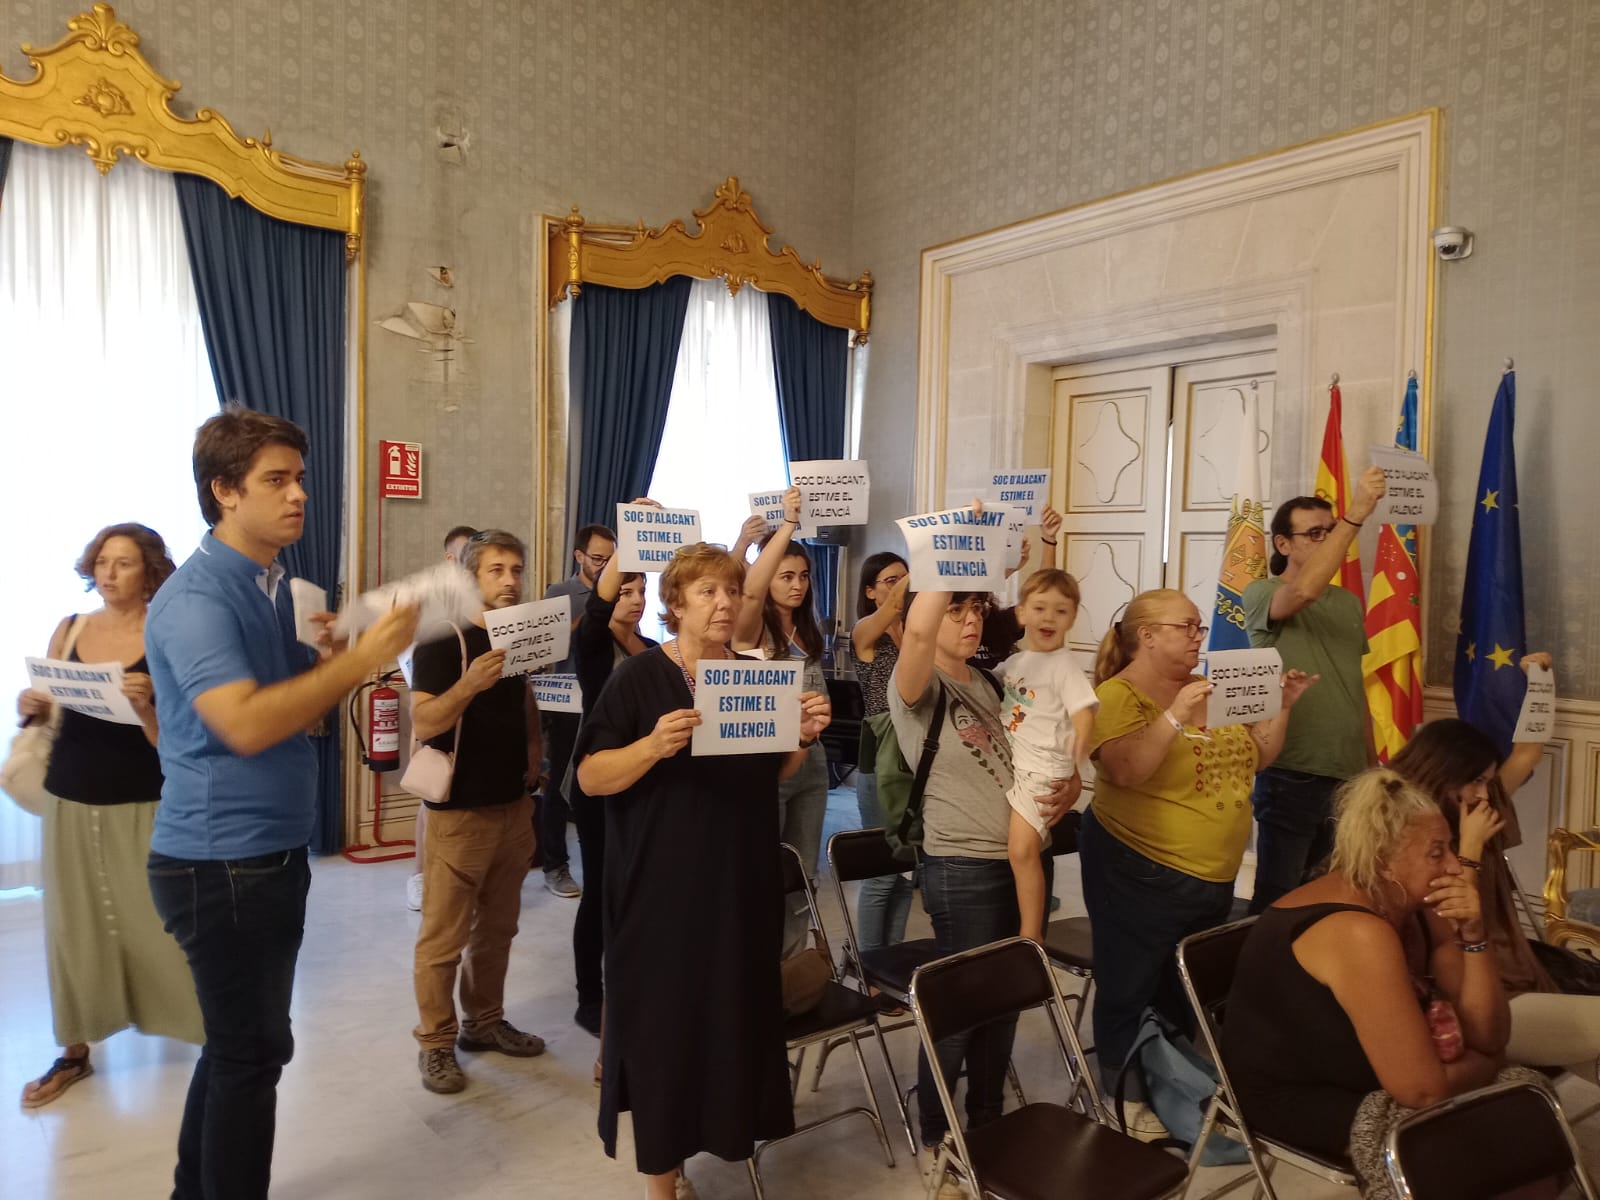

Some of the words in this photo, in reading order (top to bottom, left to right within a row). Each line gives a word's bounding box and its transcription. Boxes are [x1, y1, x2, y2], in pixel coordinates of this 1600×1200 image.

[794, 476, 815, 486] SOC
[992, 474, 1009, 485] SOC
[1010, 474, 1047, 485] D'ALACANT
[809, 492, 841, 502] ESTIME
[842, 492, 853, 502] EL
[1000, 491, 1027, 501] ESTIME
[1027, 490, 1034, 500] EL
[1389, 487, 1415, 498] ESTIME
[1416, 488, 1425, 498] EL
[753, 496, 771, 507] SOC
[766, 510, 785, 520] ESTI
[809, 506, 851, 518] VALENCIÀ
[1389, 504, 1423, 516] VALENCIÀ
[624, 510, 644, 523] SOC
[646, 512, 695, 526] D'ALACANT
[907, 516, 938, 529] SOC
[637, 530, 672, 543] ESTIME
[673, 532, 683, 544] EL
[932, 534, 973, 551] ESTIME
[975, 536, 986, 552] EL
[638, 549, 674, 562] VALENC
[936, 558, 988, 577] VALENCIÀ
[492, 623, 515, 638] SOC
[511, 634, 542, 650] ESTIME
[543, 632, 555, 642] EL
[510, 646, 552, 665] VALENCIÀ
[704, 669, 730, 686] SOC
[733, 669, 797, 686] D'ALACANT
[1212, 668, 1230, 680] SOC
[531, 680, 563, 688] STIME
[535, 692, 571, 703] ALENCIÀ
[1225, 685, 1257, 698] ESTIME
[1258, 684, 1269, 695] EL
[719, 695, 762, 712] ESTIME
[765, 695, 777, 711] EL
[1226, 700, 1265, 717] VALENCIÀ
[720, 718, 776, 739] VALENCIÀ
